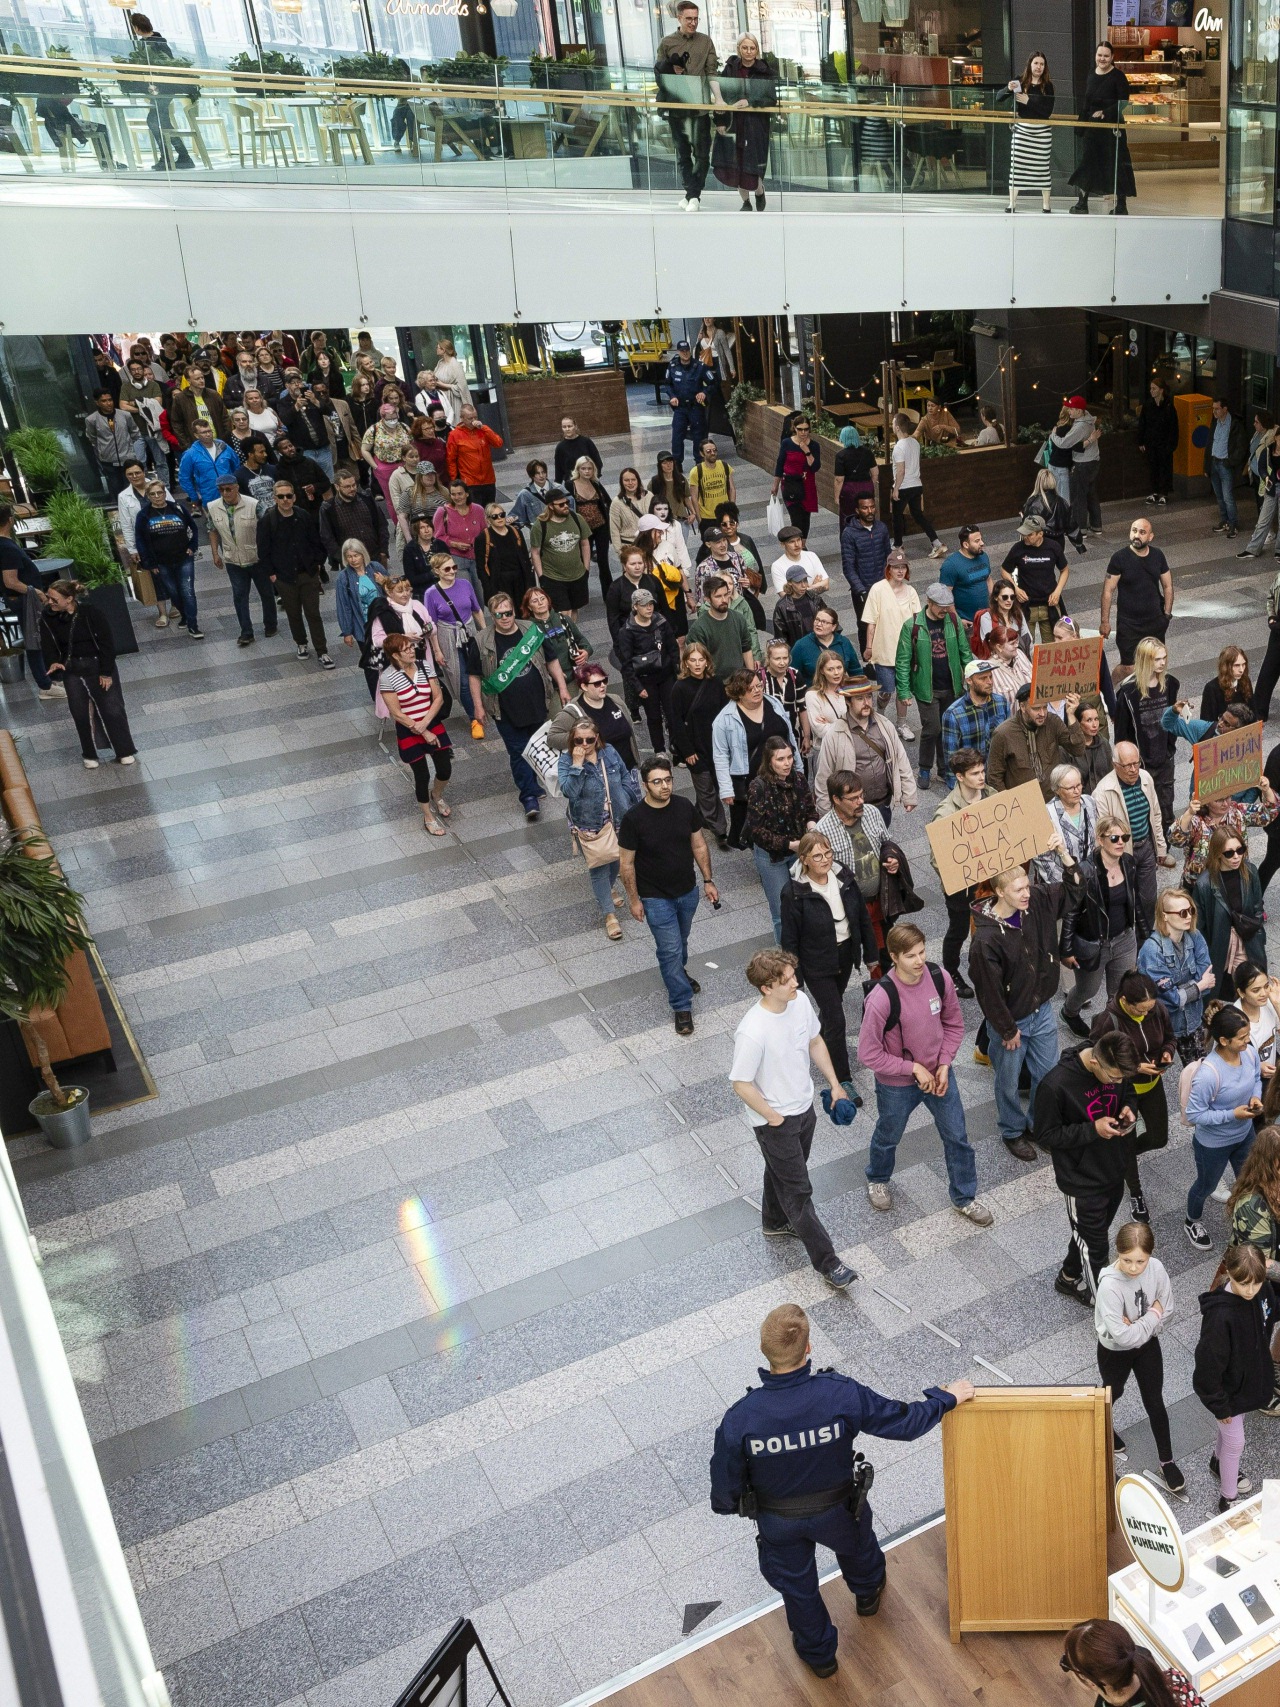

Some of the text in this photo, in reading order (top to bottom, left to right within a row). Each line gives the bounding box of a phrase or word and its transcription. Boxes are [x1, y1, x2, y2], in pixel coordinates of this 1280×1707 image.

[1037, 649, 1052, 666] EI
[1036, 684, 1054, 699] NEJ
[1056, 683, 1072, 694] TILL
[1198, 741, 1218, 773] EI
[952, 827, 1011, 865] OLLA
[962, 834, 1038, 886] RASISTI
[749, 1422, 841, 1456] POLIISI
[1125, 1515, 1168, 1537] KÄYTETYT
[1130, 1534, 1176, 1556] PUHELIMET
